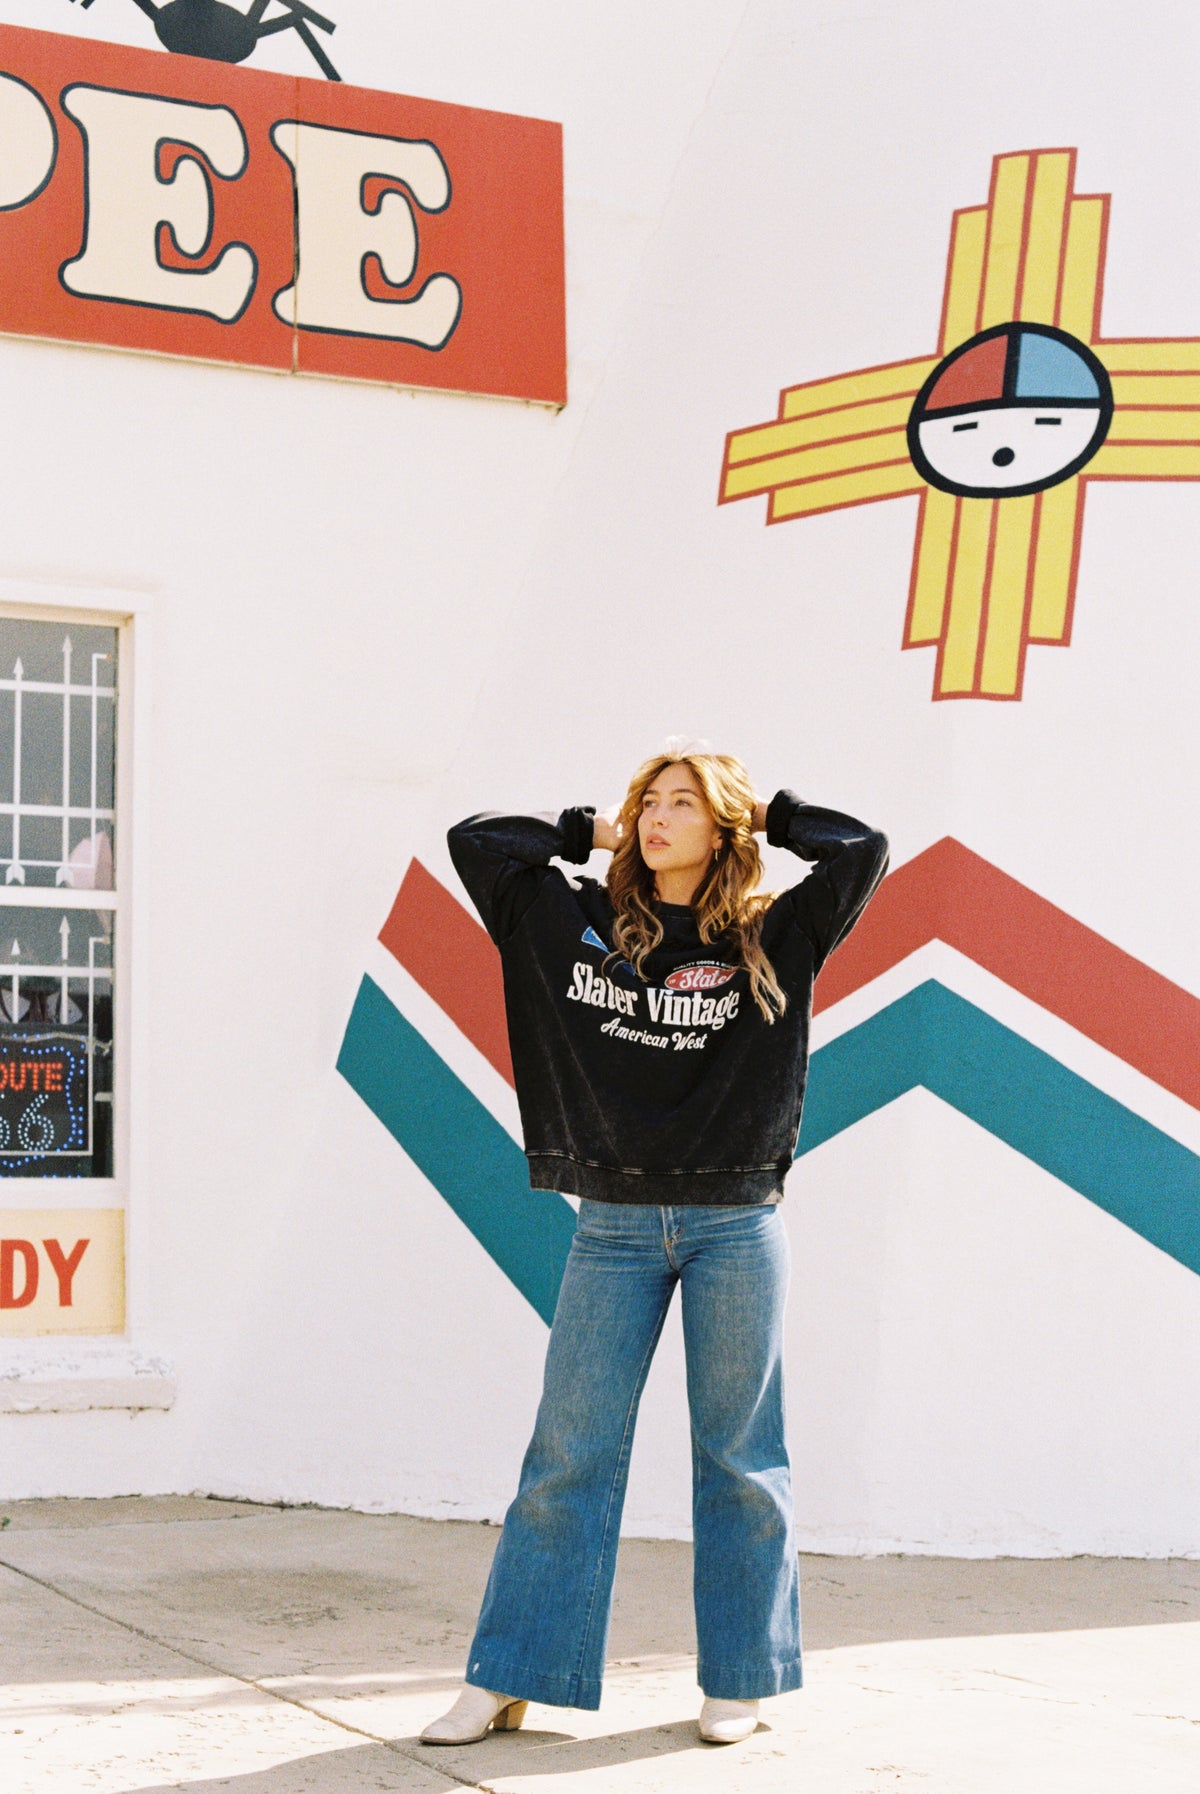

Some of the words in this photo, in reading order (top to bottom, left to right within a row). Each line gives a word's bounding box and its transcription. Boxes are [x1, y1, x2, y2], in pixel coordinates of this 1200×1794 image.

[566, 961, 638, 1017] Slater
[646, 987, 740, 1031] Vintage
[600, 1017, 669, 1049] American
[671, 1031, 708, 1051] West
[0, 1093, 55, 1152] 6
[0, 1239, 91, 1309] DY
